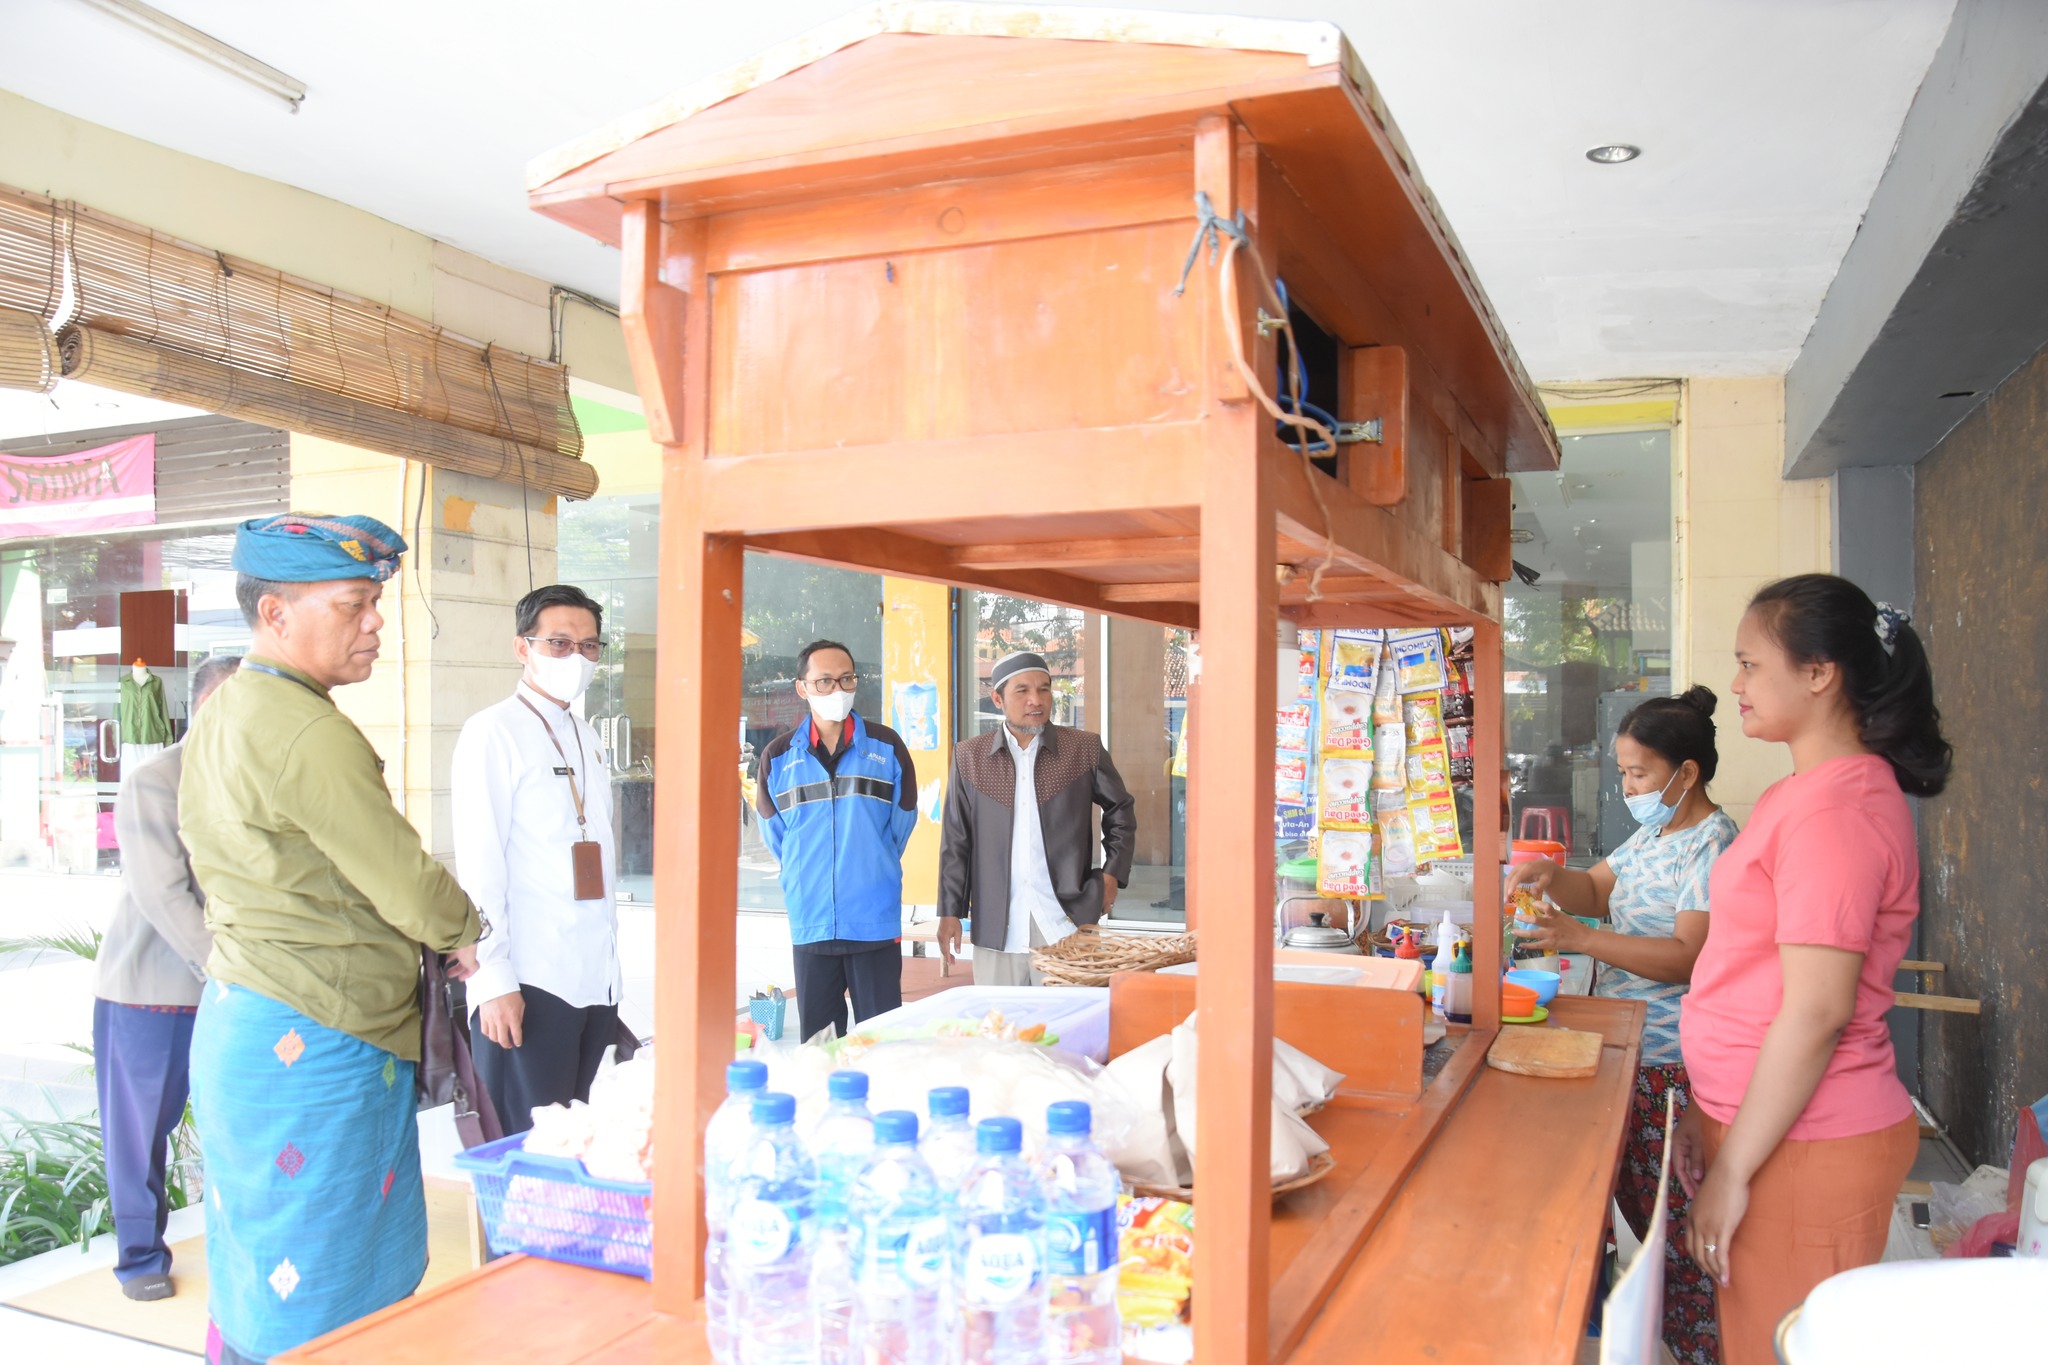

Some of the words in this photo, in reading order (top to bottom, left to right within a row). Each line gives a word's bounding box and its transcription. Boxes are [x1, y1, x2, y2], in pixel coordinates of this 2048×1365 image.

[1326, 735, 1345, 747] Day
[1346, 737, 1372, 748] Good
[1324, 808, 1343, 820] Day
[1344, 810, 1370, 821] Good
[1323, 879, 1341, 892] Day
[1342, 883, 1368, 894] Good
[980, 1251, 1025, 1271] AQUA
